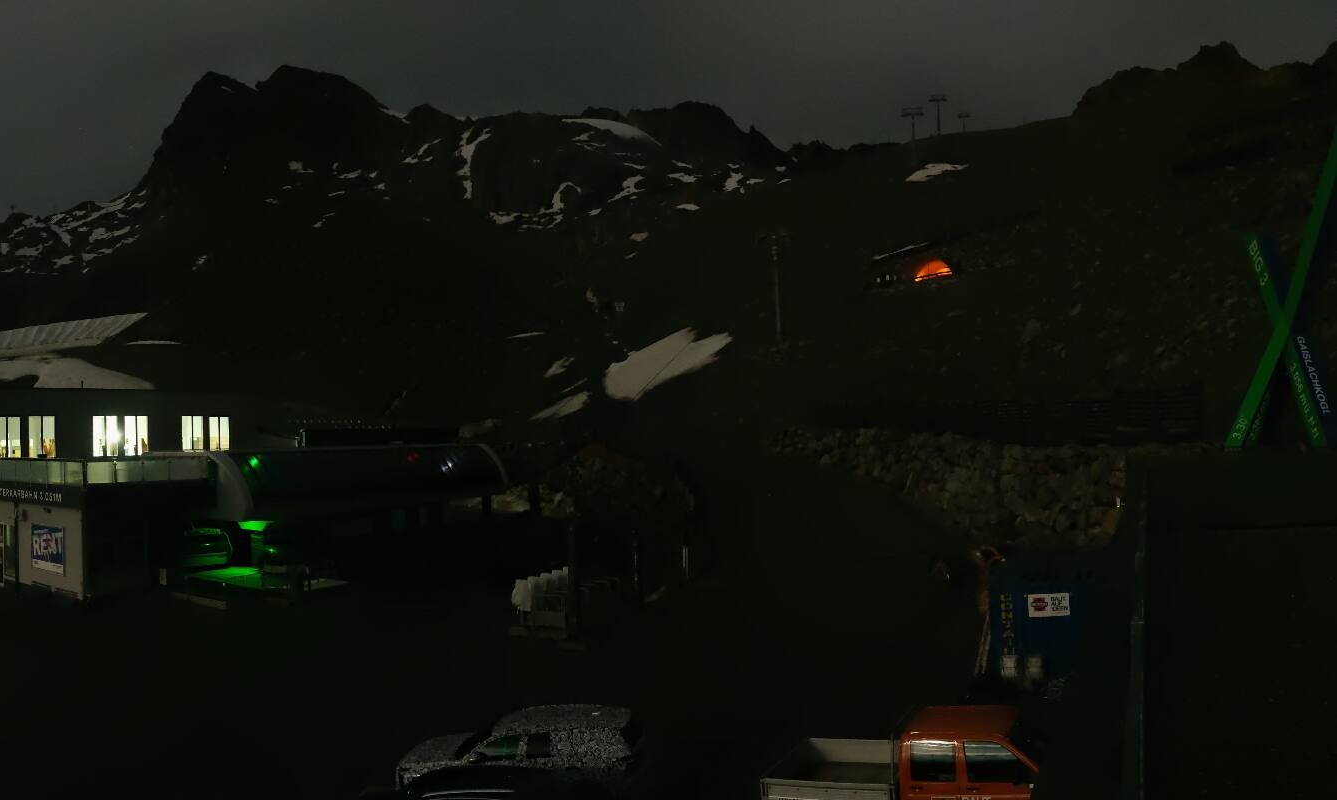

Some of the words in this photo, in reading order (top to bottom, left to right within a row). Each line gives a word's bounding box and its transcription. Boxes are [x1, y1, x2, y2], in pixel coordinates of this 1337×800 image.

[1247, 239, 1264, 273] BIG
[1259, 272, 1269, 287] 3
[1296, 335, 1332, 416] GAISLACHKOGL
[33, 532, 63, 557] RENT
